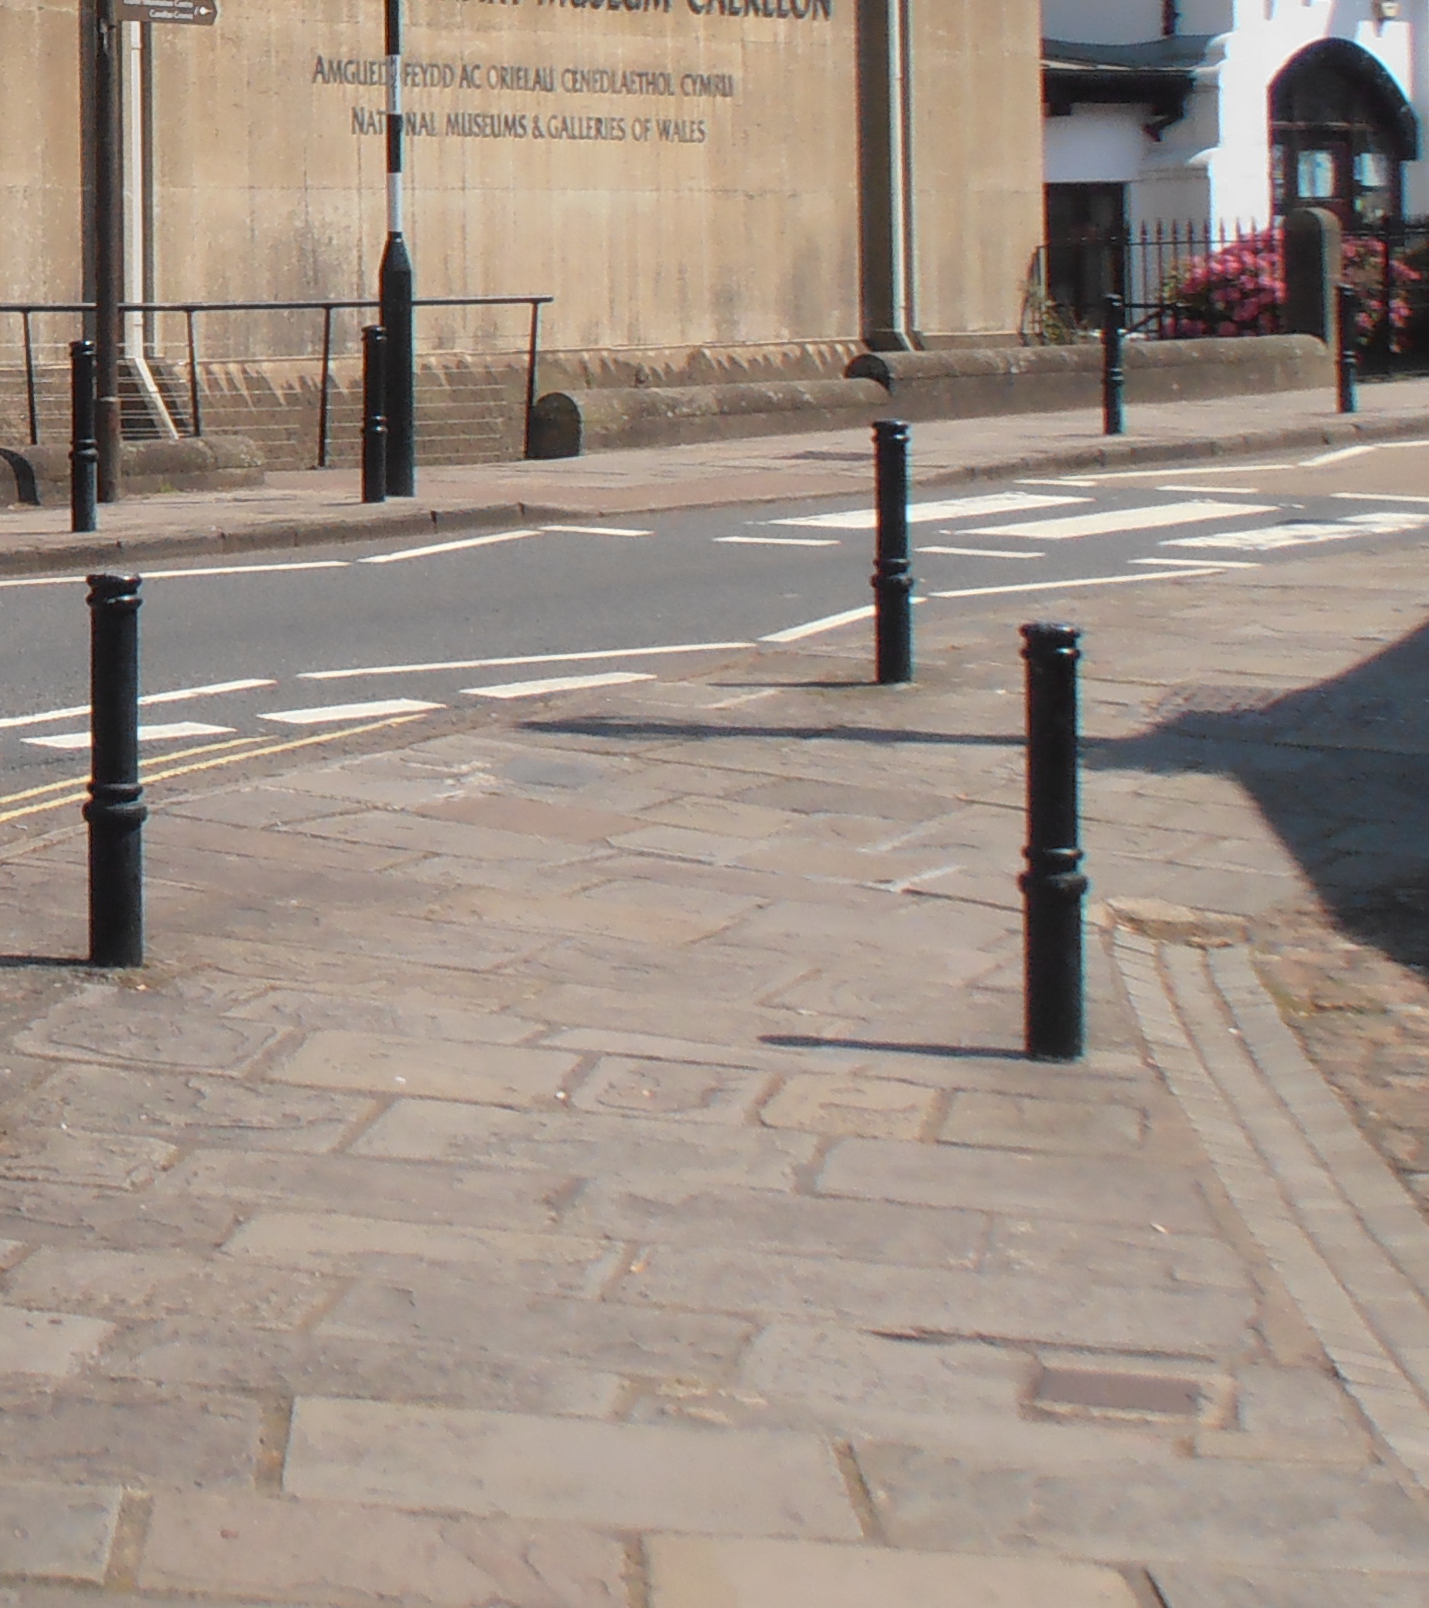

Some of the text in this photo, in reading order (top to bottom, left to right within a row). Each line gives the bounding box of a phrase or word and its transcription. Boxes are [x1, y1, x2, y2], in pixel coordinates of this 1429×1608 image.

[459, 63, 482, 90] AC
[487, 65, 554, 92] ORIELAU
[561, 68, 675, 96] CENEDLAETHOL
[680, 72, 734, 97] CYMRU
[445, 113, 527, 139] MUSEUMS
[532, 115, 545, 140] &
[547, 115, 626, 142] GALLERIES
[631, 118, 651, 142] OF
[656, 119, 706, 143] WALES
